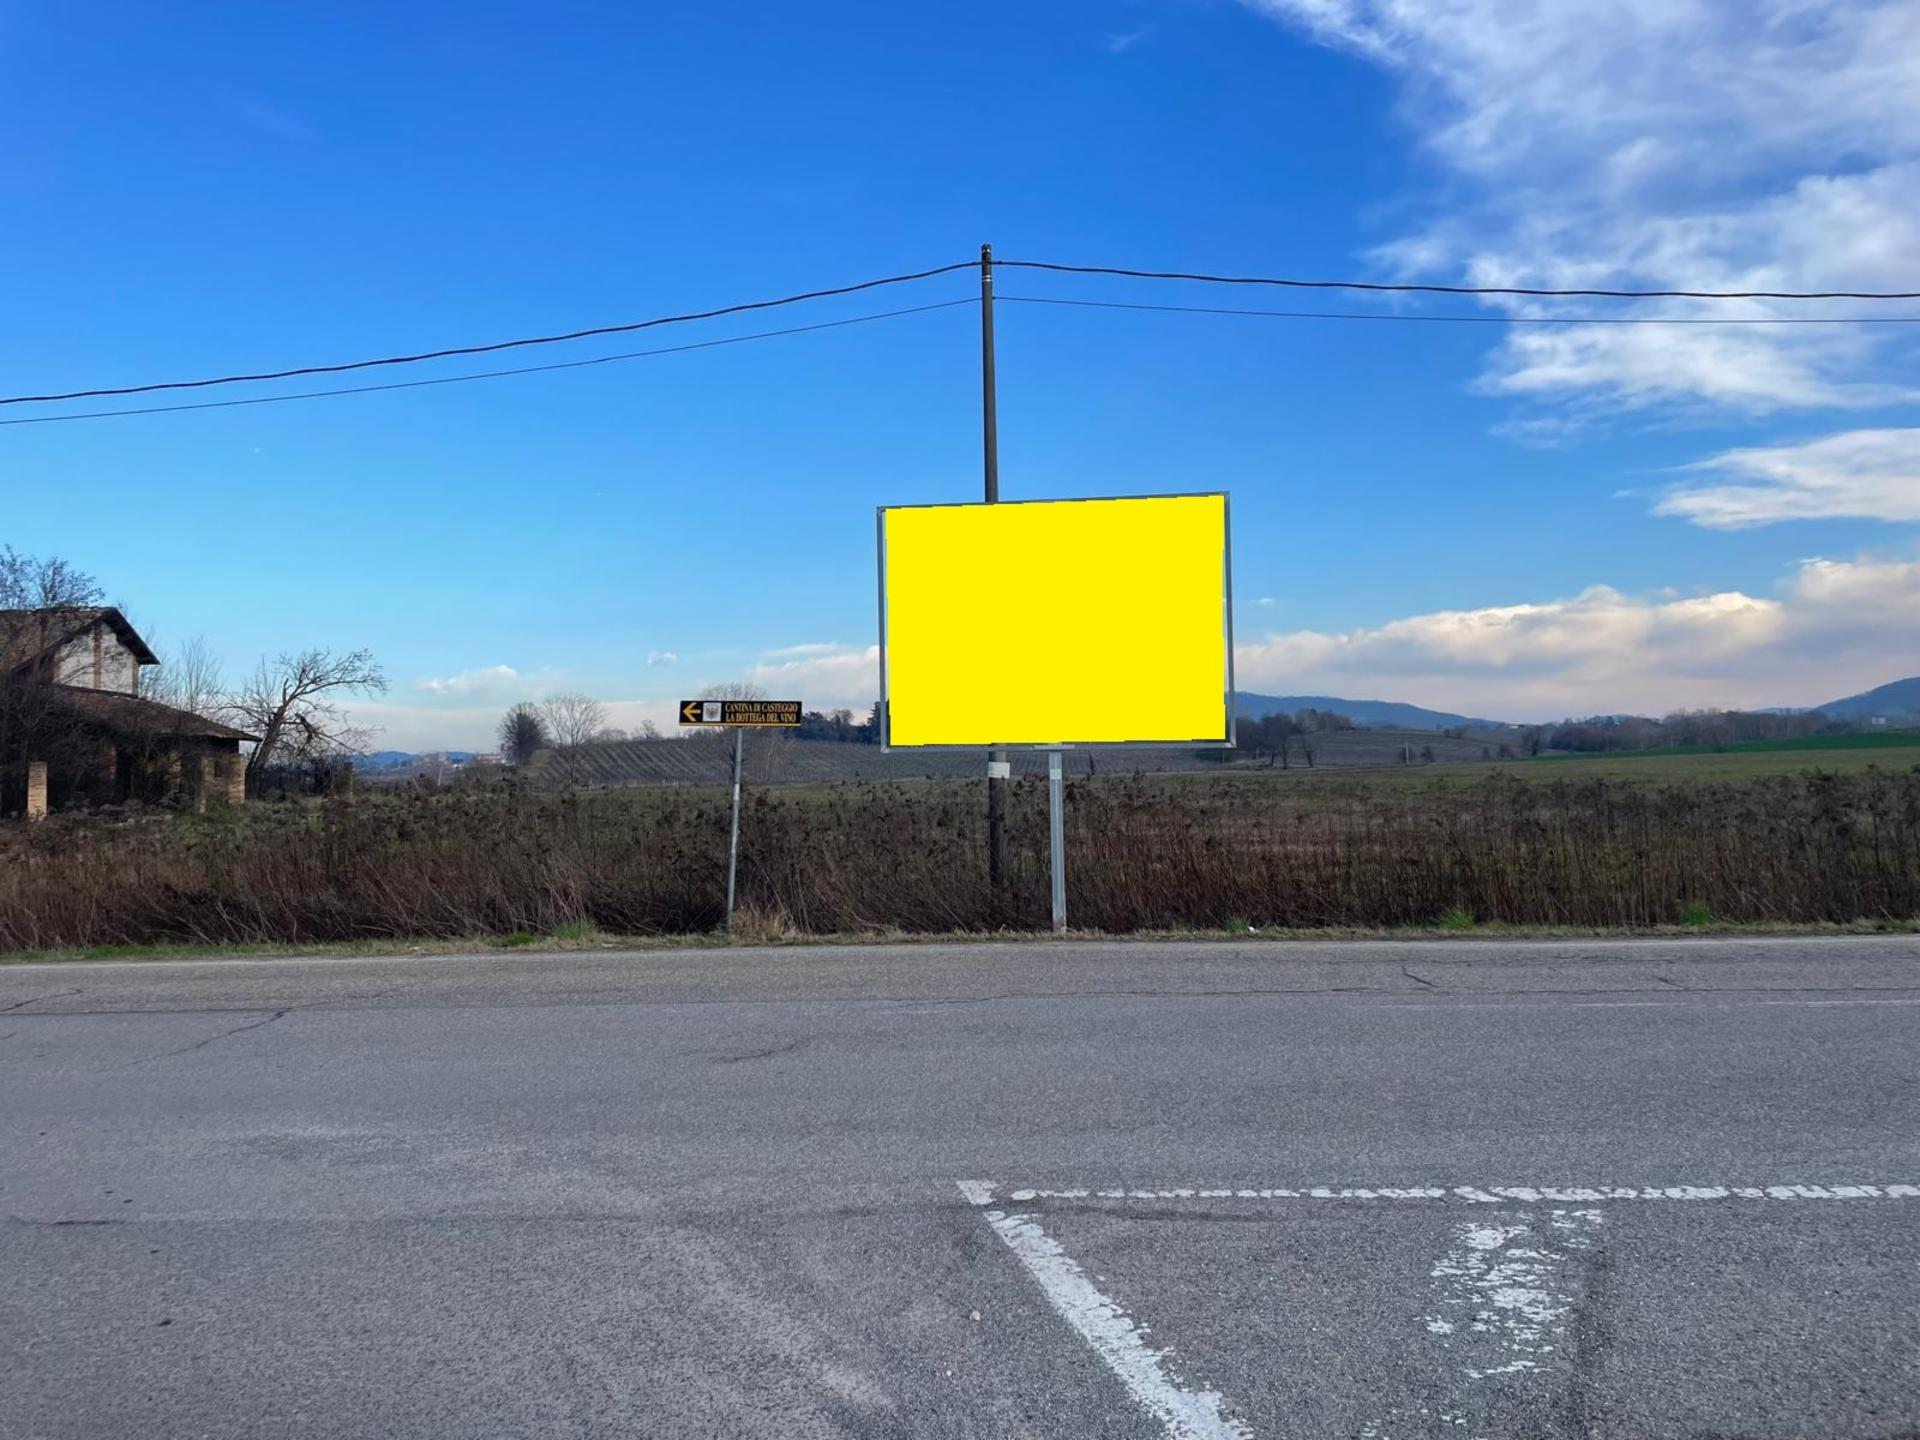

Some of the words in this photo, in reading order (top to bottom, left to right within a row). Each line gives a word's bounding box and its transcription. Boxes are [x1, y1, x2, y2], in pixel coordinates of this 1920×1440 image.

[725, 703, 752, 712] CANTINA
[753, 703, 761, 712] DI
[762, 703, 798, 712] CASTEGGIO
[726, 713, 735, 722] LA
[736, 713, 765, 722] BOTTEGA
[766, 713, 779, 722] DEL
[780, 713, 797, 722] VINO
